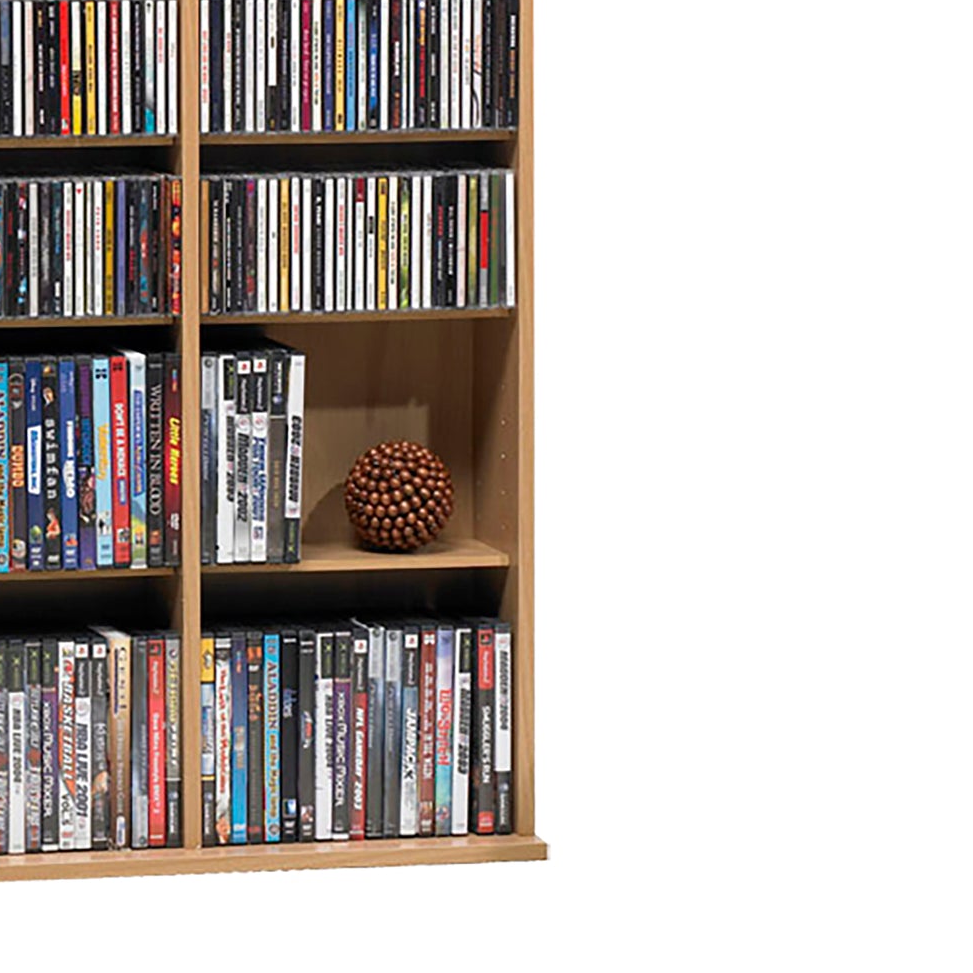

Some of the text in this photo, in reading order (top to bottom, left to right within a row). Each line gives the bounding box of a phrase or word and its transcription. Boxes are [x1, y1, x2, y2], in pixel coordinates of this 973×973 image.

[150, 384, 162, 451] WRITTEN
[45, 418, 59, 499] swimfan
[150, 473, 162, 515] BLOOD
